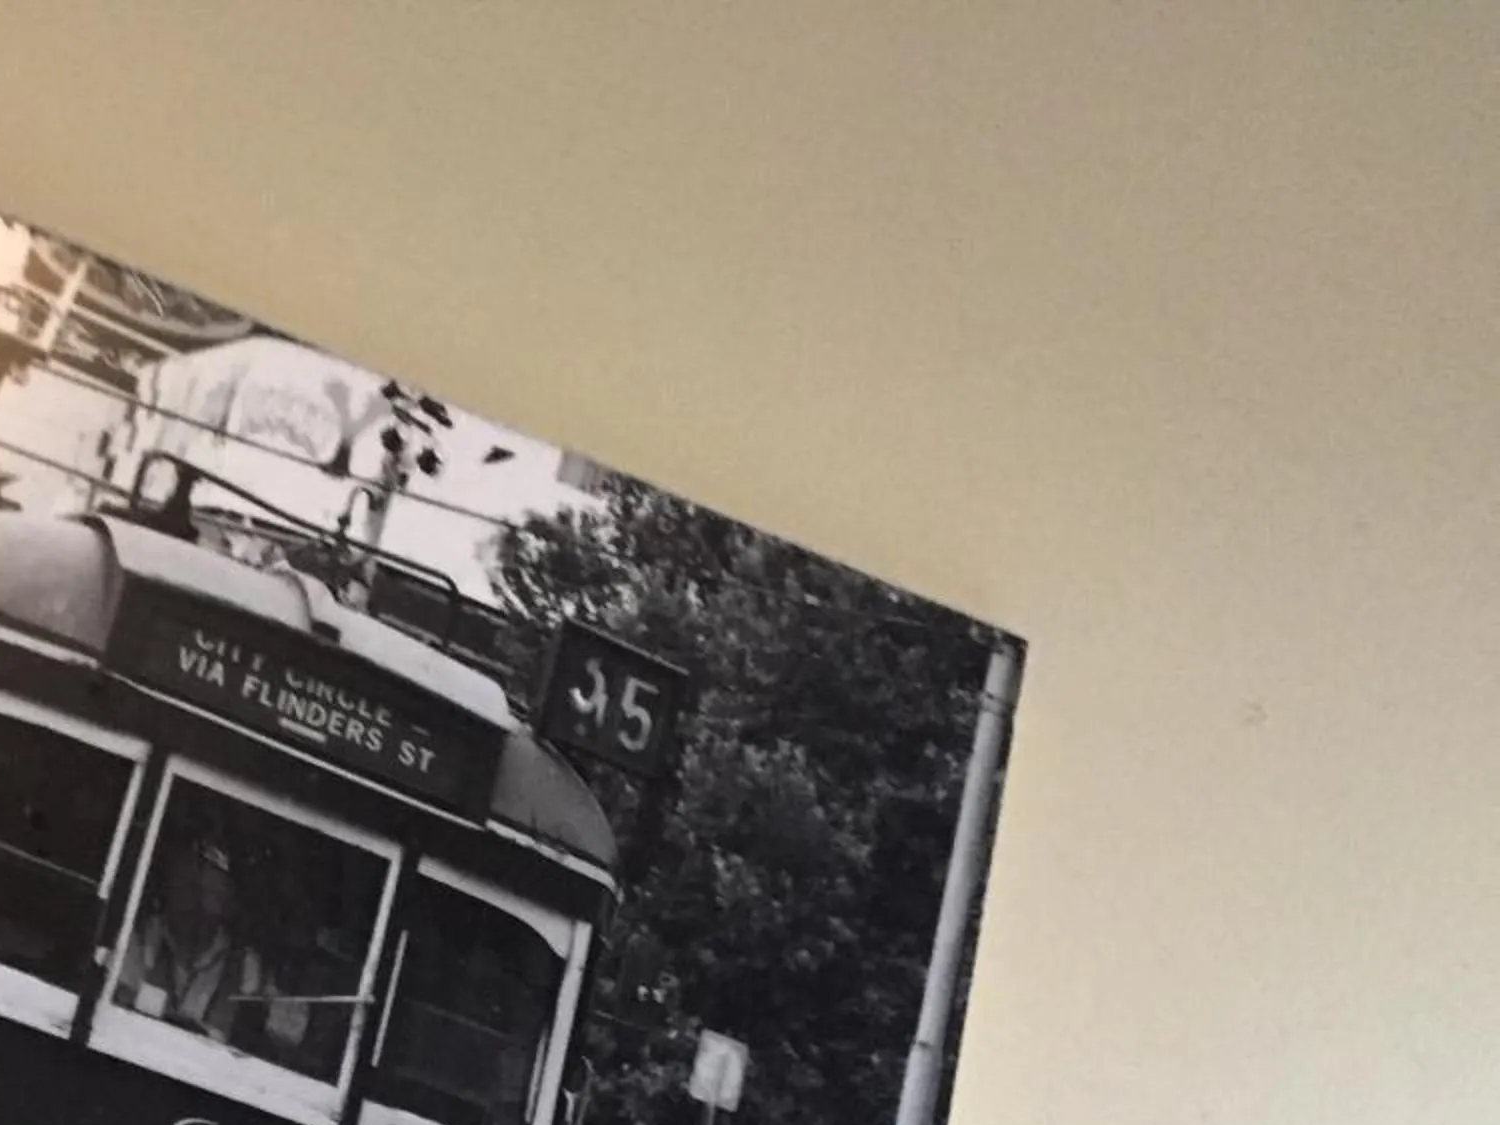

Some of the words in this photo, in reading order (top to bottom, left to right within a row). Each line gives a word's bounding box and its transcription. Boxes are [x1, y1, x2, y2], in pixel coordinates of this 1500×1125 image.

[179, 645, 225, 688] VIA
[241, 672, 383, 752] FLINDERS
[397, 739, 436, 774] ST
